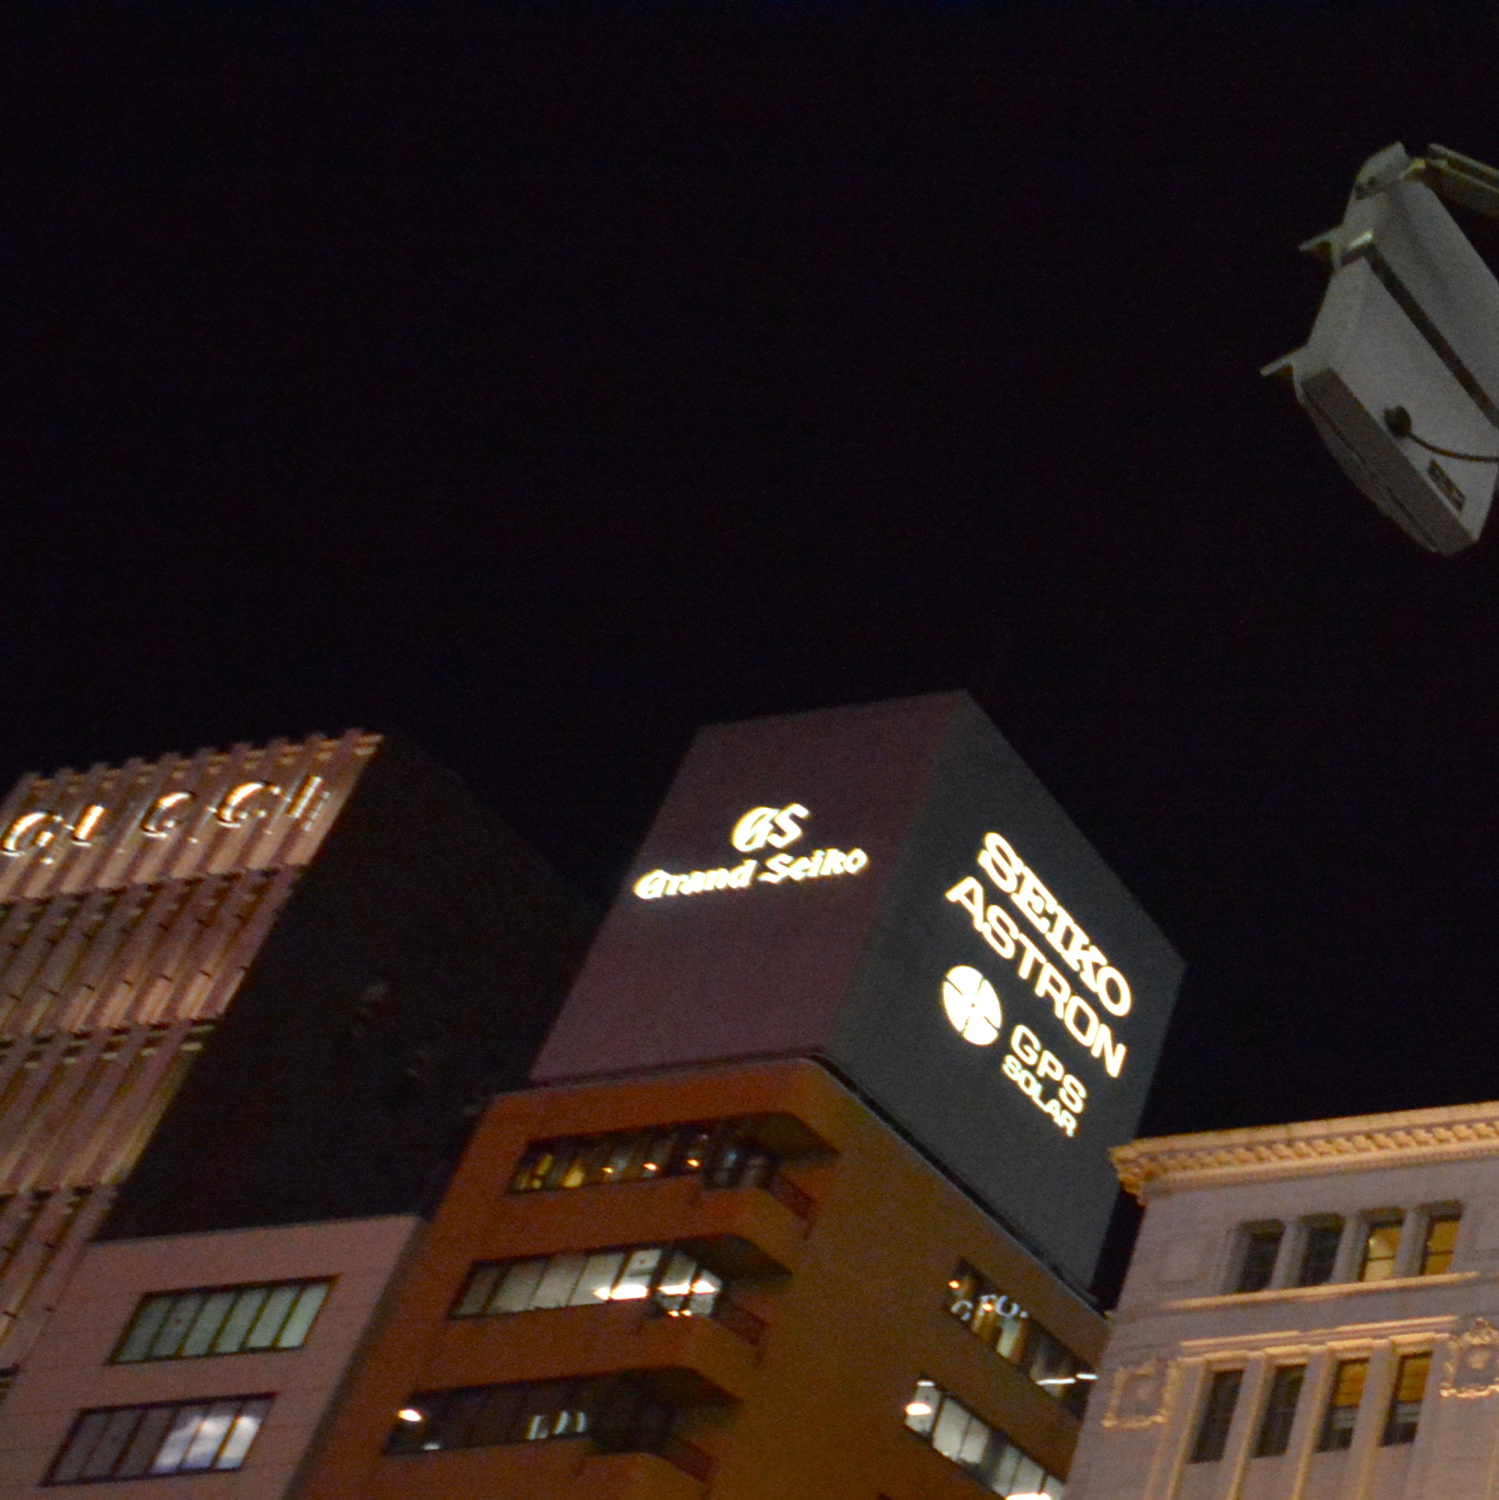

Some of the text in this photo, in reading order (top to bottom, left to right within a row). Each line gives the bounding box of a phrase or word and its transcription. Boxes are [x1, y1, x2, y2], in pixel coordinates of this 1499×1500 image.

[730, 802, 811, 853] GS
[632, 847, 868, 900] Grand Seiko
[977, 831, 1132, 1017] SEIKO
[945, 875, 1127, 1078] ASTRON
[1002, 1053, 1077, 1138] SOLAR
[1010, 1023, 1087, 1114] GPS
